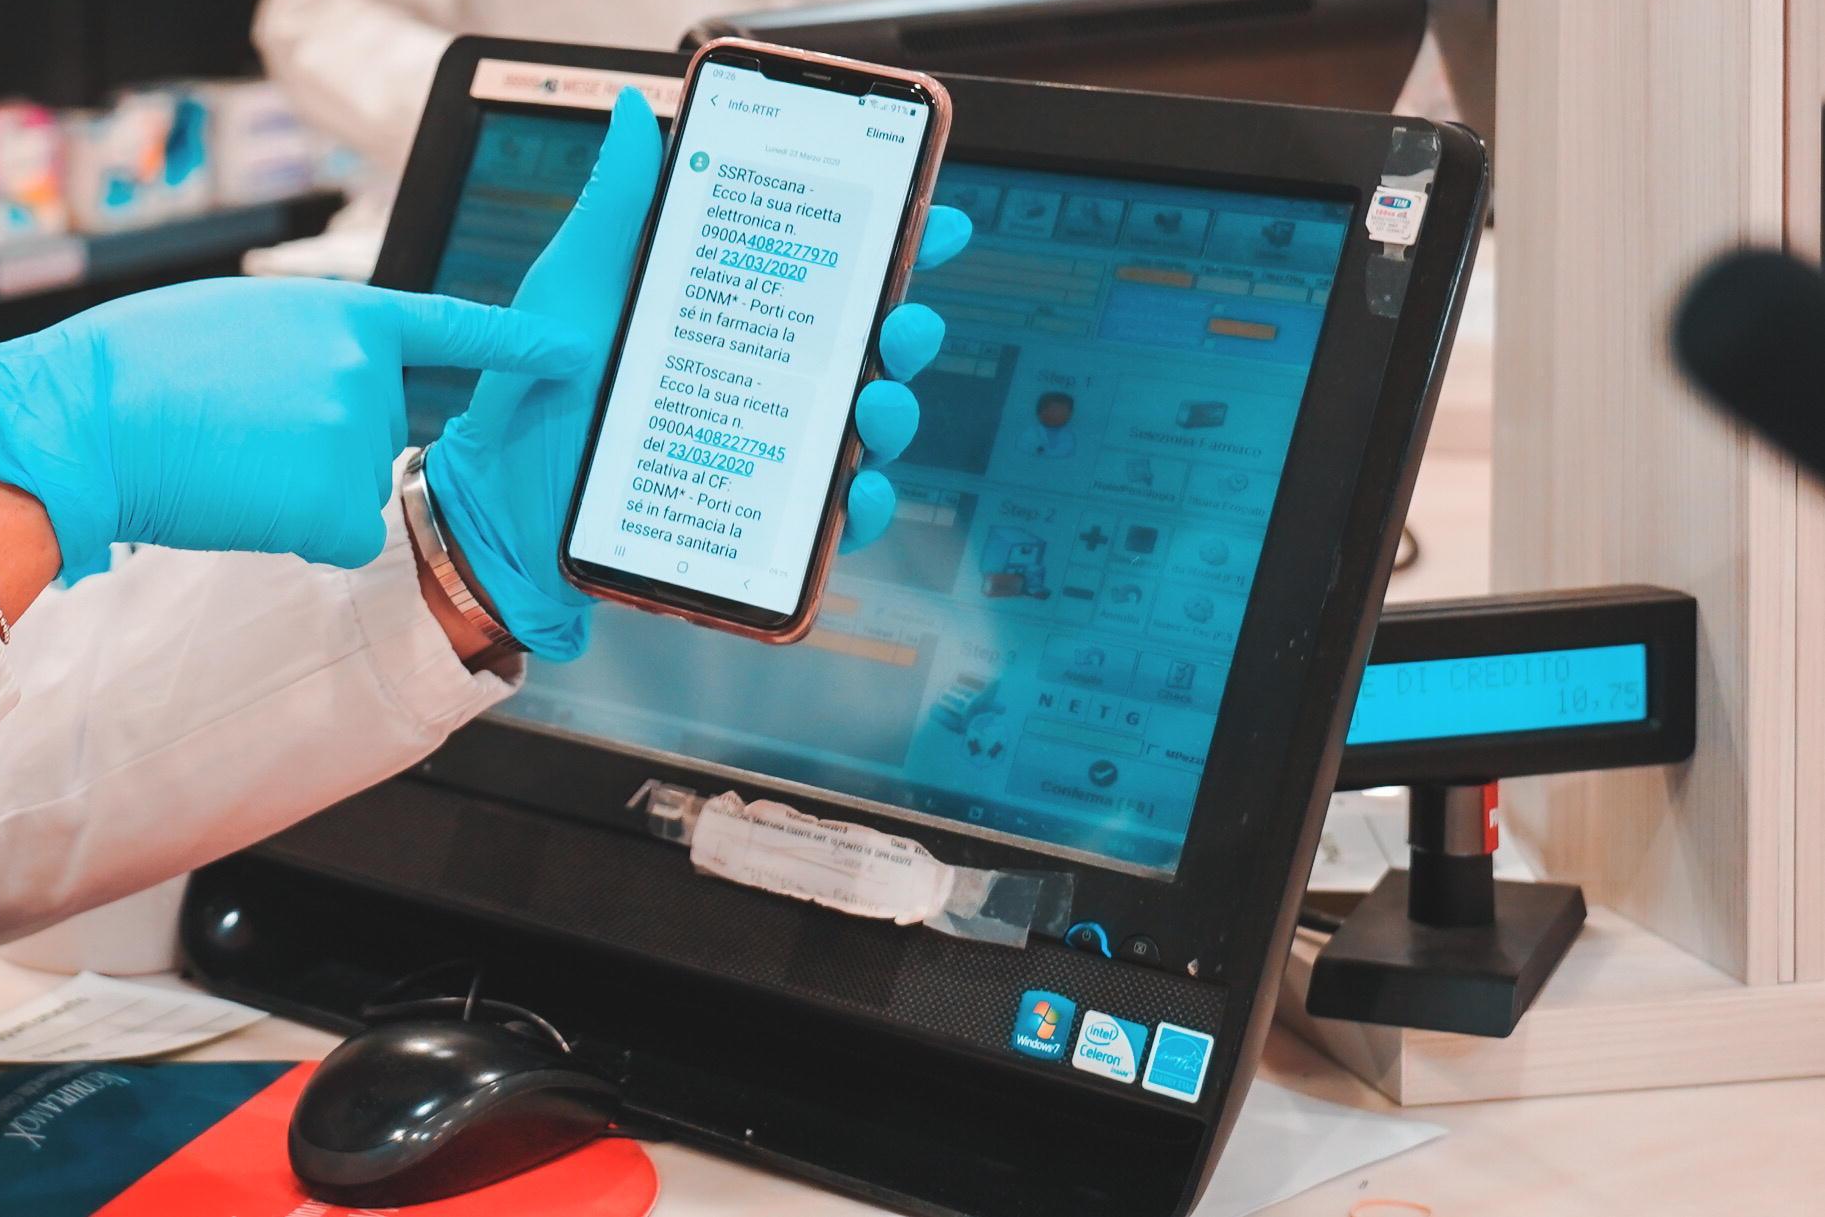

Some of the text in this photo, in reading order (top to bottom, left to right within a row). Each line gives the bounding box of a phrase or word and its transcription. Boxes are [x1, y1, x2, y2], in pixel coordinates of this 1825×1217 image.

[866, 127, 905, 144] Elimina
[717, 164, 805, 194] SSRToscana
[707, 205, 797, 236] elettronica n.
[712, 184, 842, 223] Ecco la sua ricetta
[701, 224, 839, 267] 0900A4082277970
[695, 244, 807, 282] del 23/03/2020
[690, 266, 784, 297] relativa al CF:
[679, 306, 795, 343] sé in farmacia la
[750, 298, 786, 319] Porti
[788, 310, 815, 325] con
[674, 325, 791, 363] tessera sanitaria
[665, 354, 753, 387] SSRToscana
[654, 396, 744, 430] elettronica n.
[659, 375, 790, 418] Ecco la sua ricetta
[648, 415, 787, 463] 0900A4082277945
[643, 436, 755, 477] del 23/03/2020
[637, 458, 733, 492] relativa al CF:
[626, 498, 742, 539] sé in farmacia la
[697, 493, 732, 513] Porti
[735, 505, 762, 521] con
[621, 518, 738, 559] tessera sanitaria
[1396, 666, 1428, 695] DI
[1450, 655, 1571, 692] CREDITO
[1039, 693, 1054, 707] N
[1069, 699, 1082, 714] E
[1099, 705, 1111, 719] T
[1089, 1025, 1115, 1041] intel
[1079, 1043, 1121, 1067] Celeron
